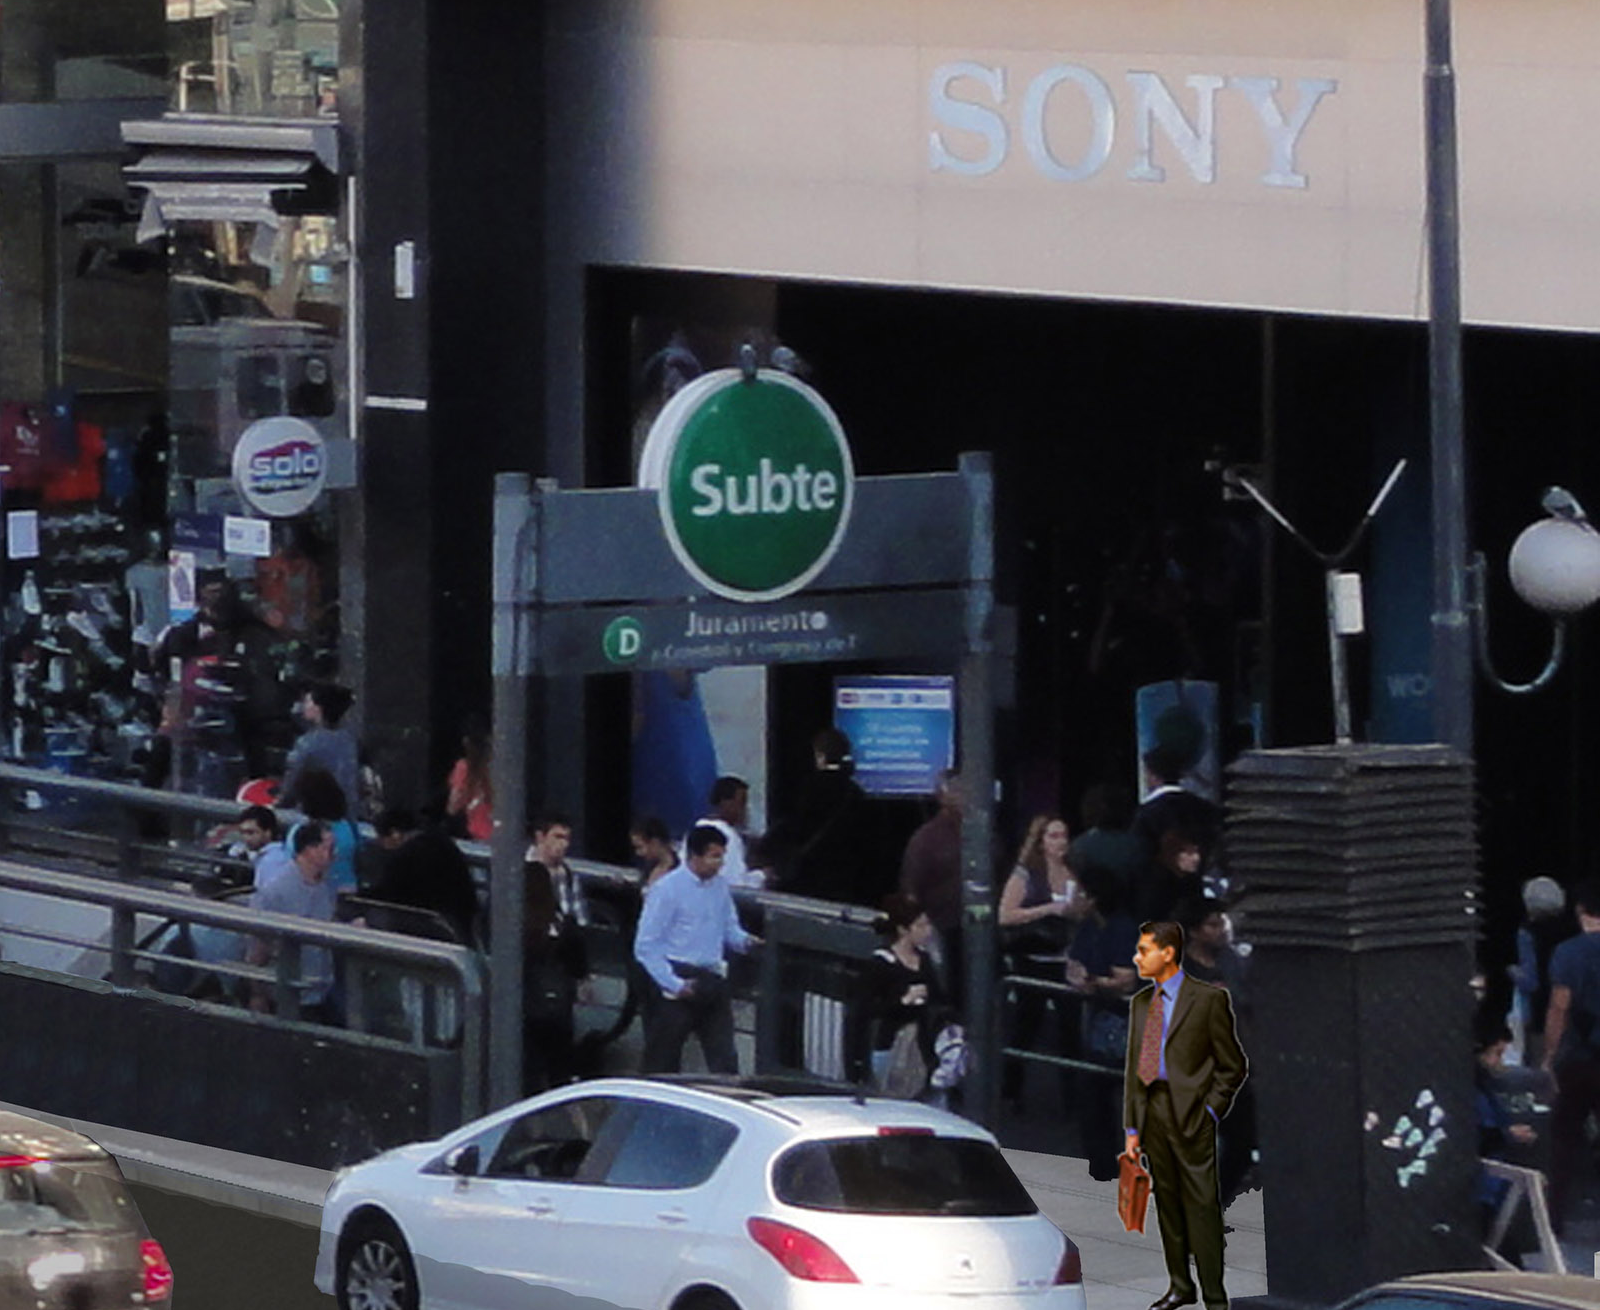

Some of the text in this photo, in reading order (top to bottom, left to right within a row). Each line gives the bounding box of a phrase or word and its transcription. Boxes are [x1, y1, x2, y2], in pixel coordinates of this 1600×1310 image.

[928, 60, 1338, 189] SONY
[251, 447, 320, 476] solo
[689, 462, 838, 518] Subte
[618, 628, 640, 656] D
